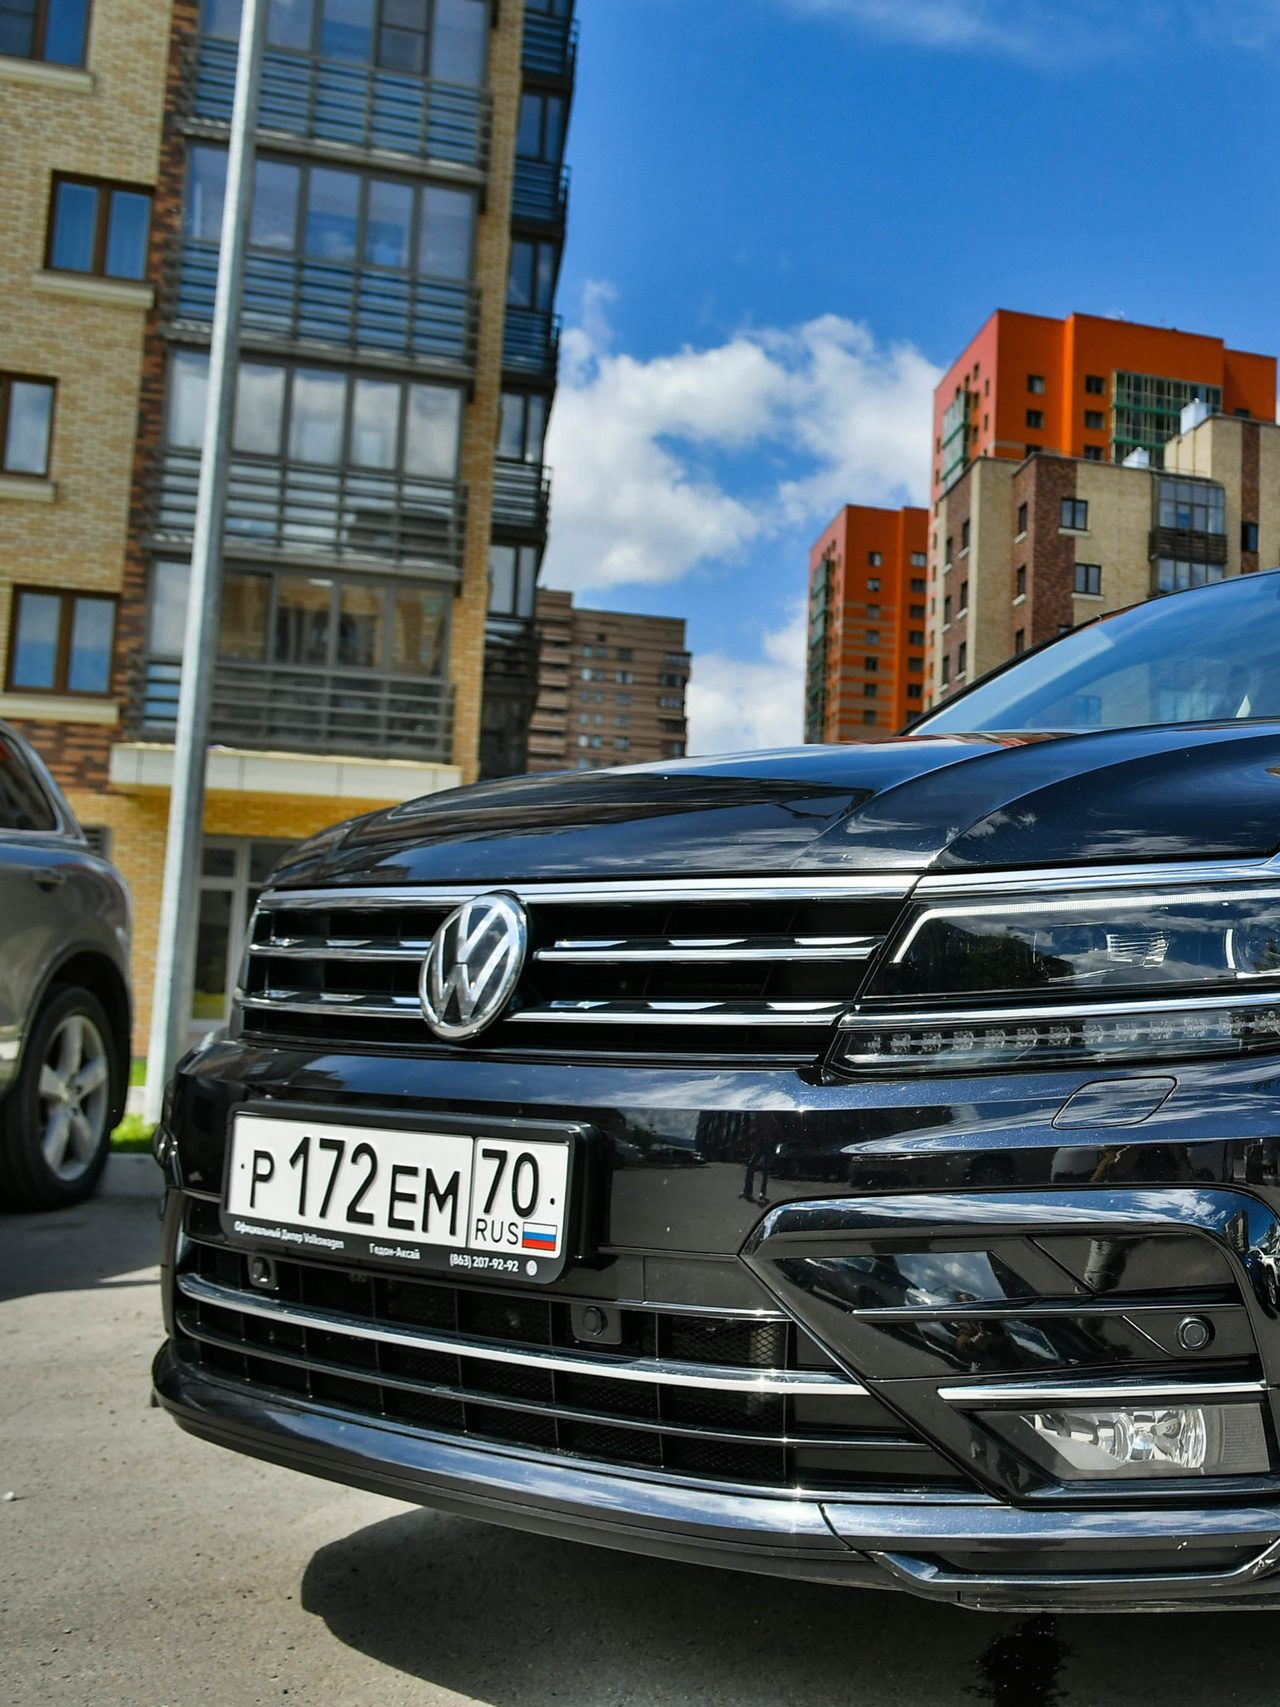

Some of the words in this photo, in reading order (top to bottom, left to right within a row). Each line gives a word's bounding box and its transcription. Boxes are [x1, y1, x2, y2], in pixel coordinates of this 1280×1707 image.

[481, 1148, 539, 1218] 70
[474, 1217, 519, 1246] RUS
[449, 1253, 472, 1269] (863)
[472, 1256, 519, 1272] 207-92-92
